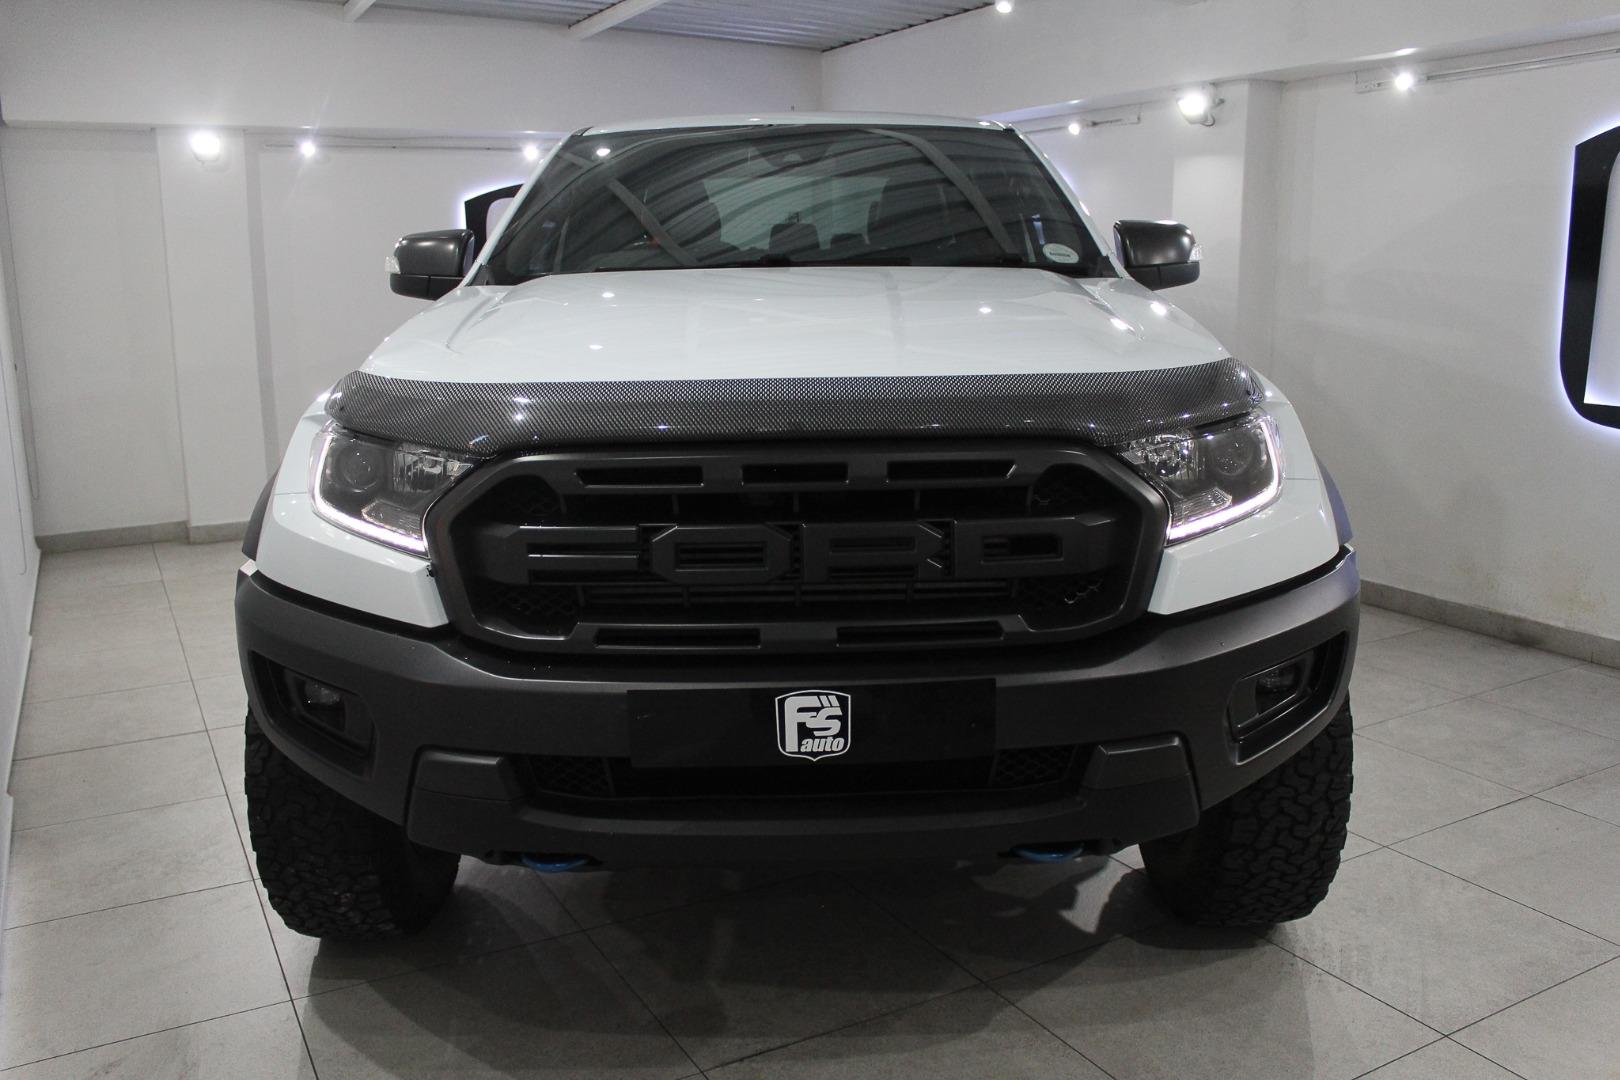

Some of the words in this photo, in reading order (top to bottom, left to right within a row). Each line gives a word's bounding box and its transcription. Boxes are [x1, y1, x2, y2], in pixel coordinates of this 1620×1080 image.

[488, 517, 1114, 585] FORD
[784, 695, 843, 752] FS
[800, 736, 845, 752] auto
